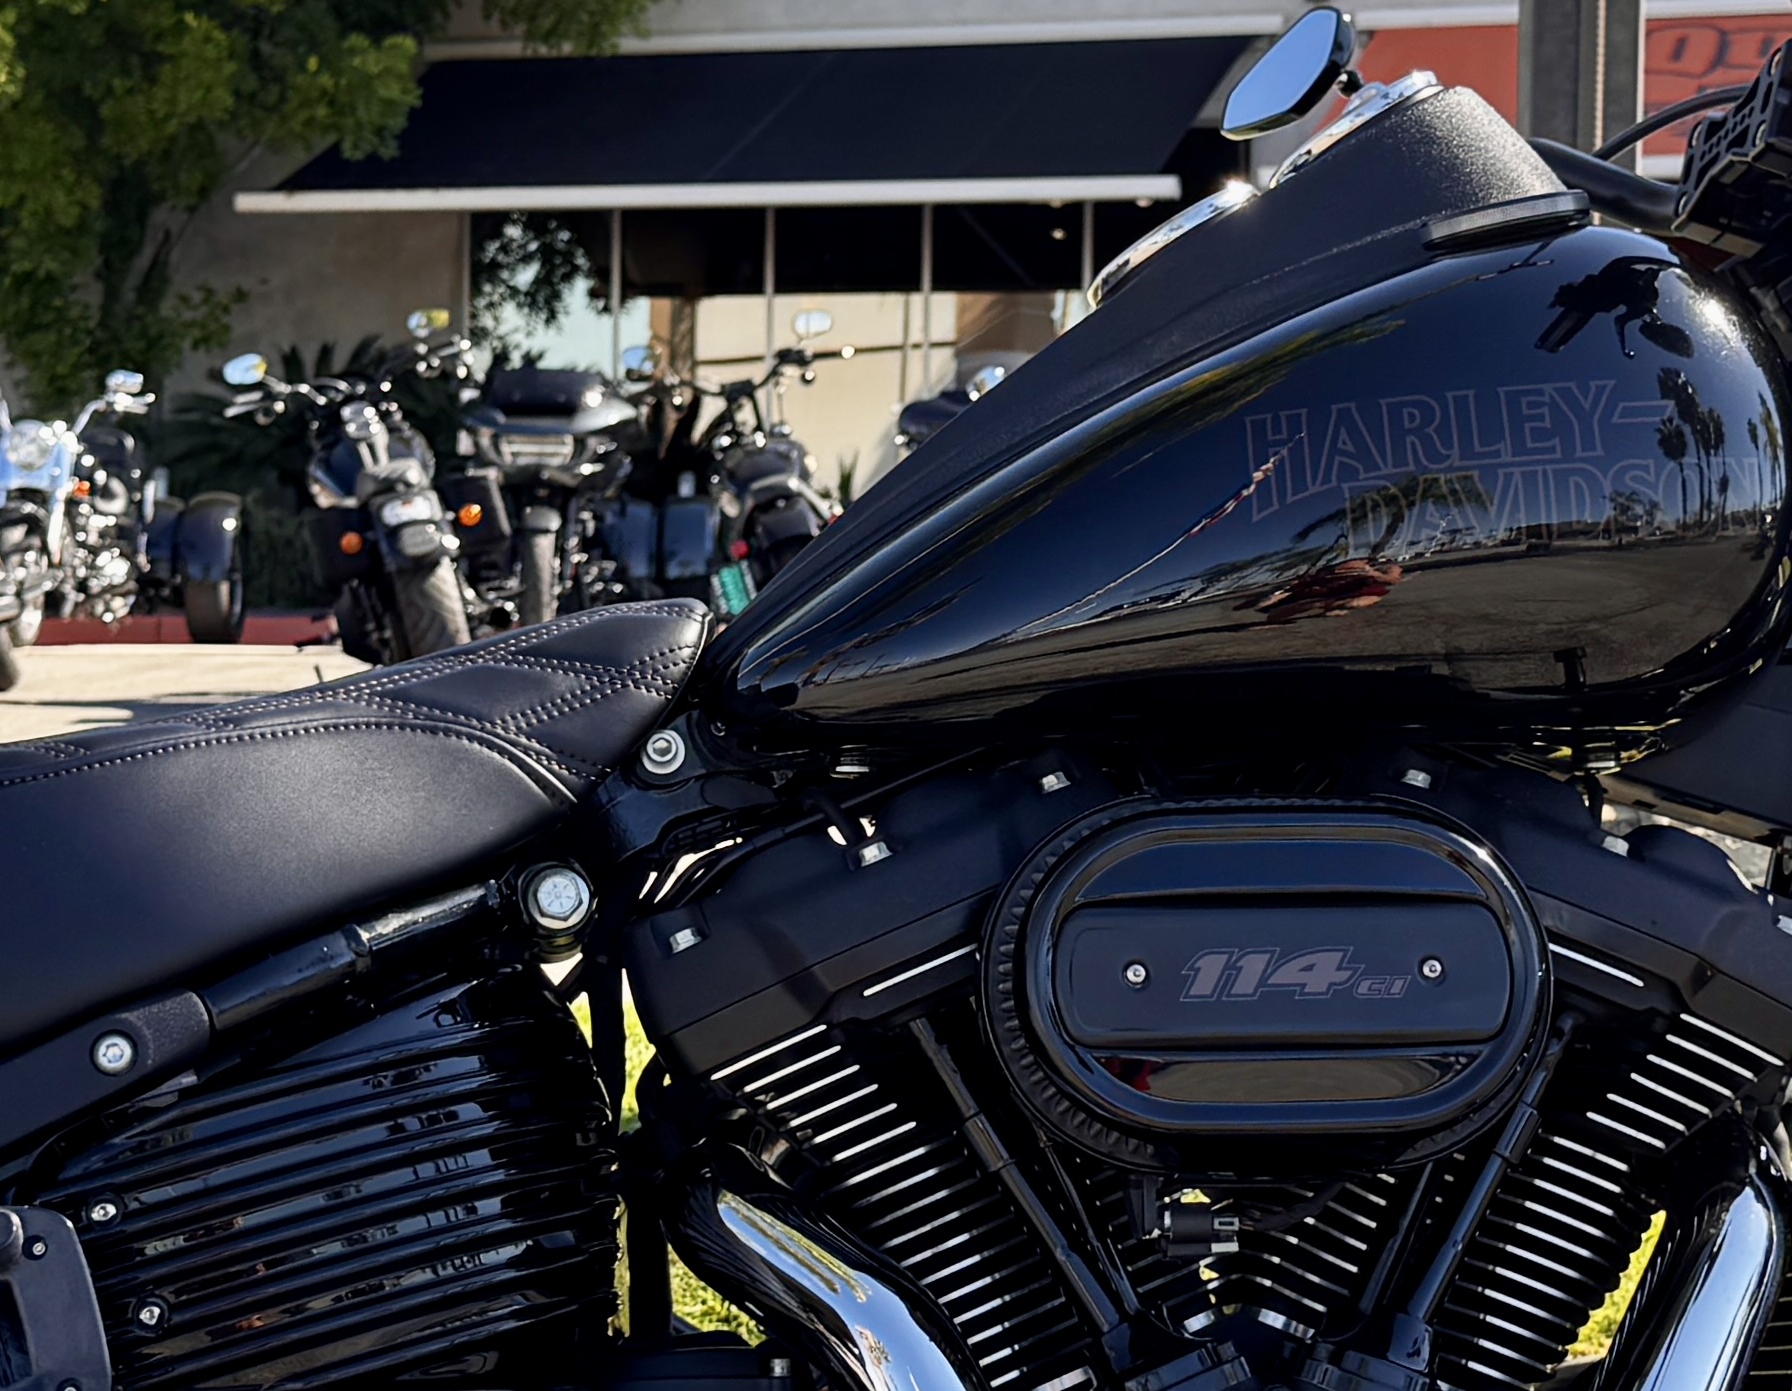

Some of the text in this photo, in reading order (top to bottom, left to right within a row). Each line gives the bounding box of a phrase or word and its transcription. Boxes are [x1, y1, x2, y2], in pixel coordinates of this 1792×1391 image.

[1244, 380, 1676, 523] HARLEY-
[1342, 458, 1765, 559] DAVIDSON
[1180, 945, 1365, 1002] 114
